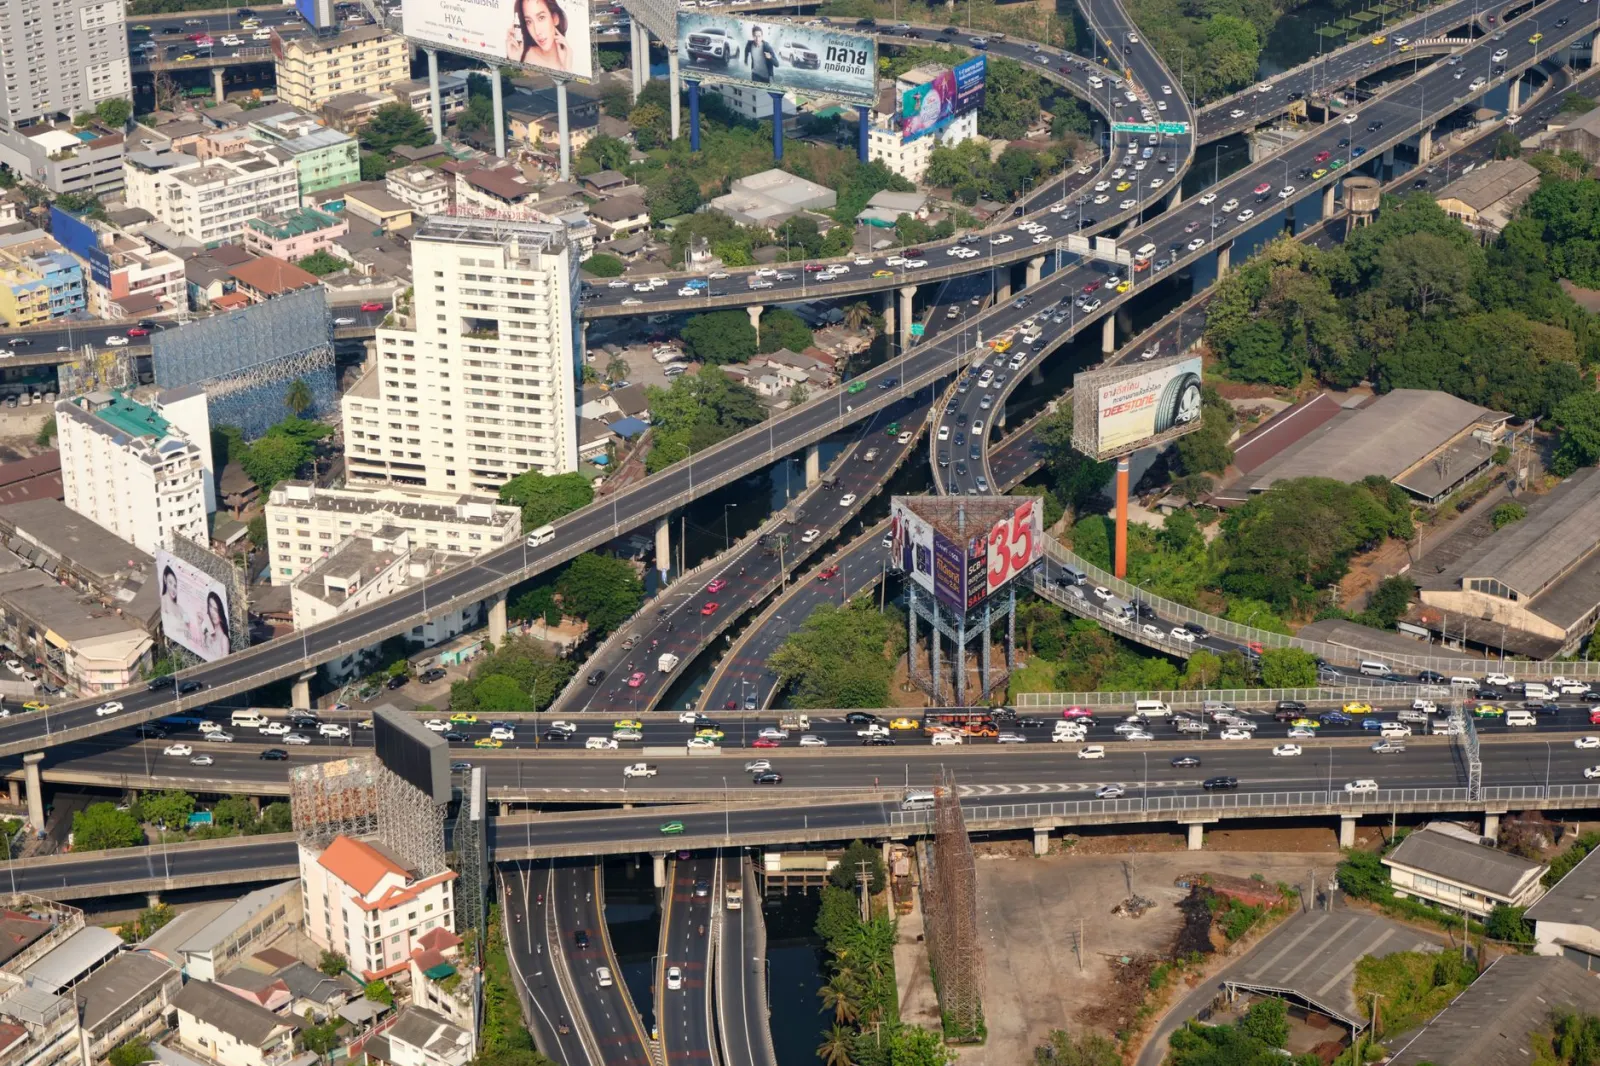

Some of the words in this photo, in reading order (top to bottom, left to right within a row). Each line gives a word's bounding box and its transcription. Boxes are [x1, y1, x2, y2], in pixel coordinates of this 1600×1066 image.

[444, 13, 464, 26] HYA
[826, 45, 868, 66] ทลาย
[824, 62, 866, 75] ทุกขีดจำกัด
[1103, 394, 1156, 417] DEESTONE
[987, 500, 1032, 587] 35
[968, 561, 981, 576] SCB
[968, 588, 987, 608] SALE
